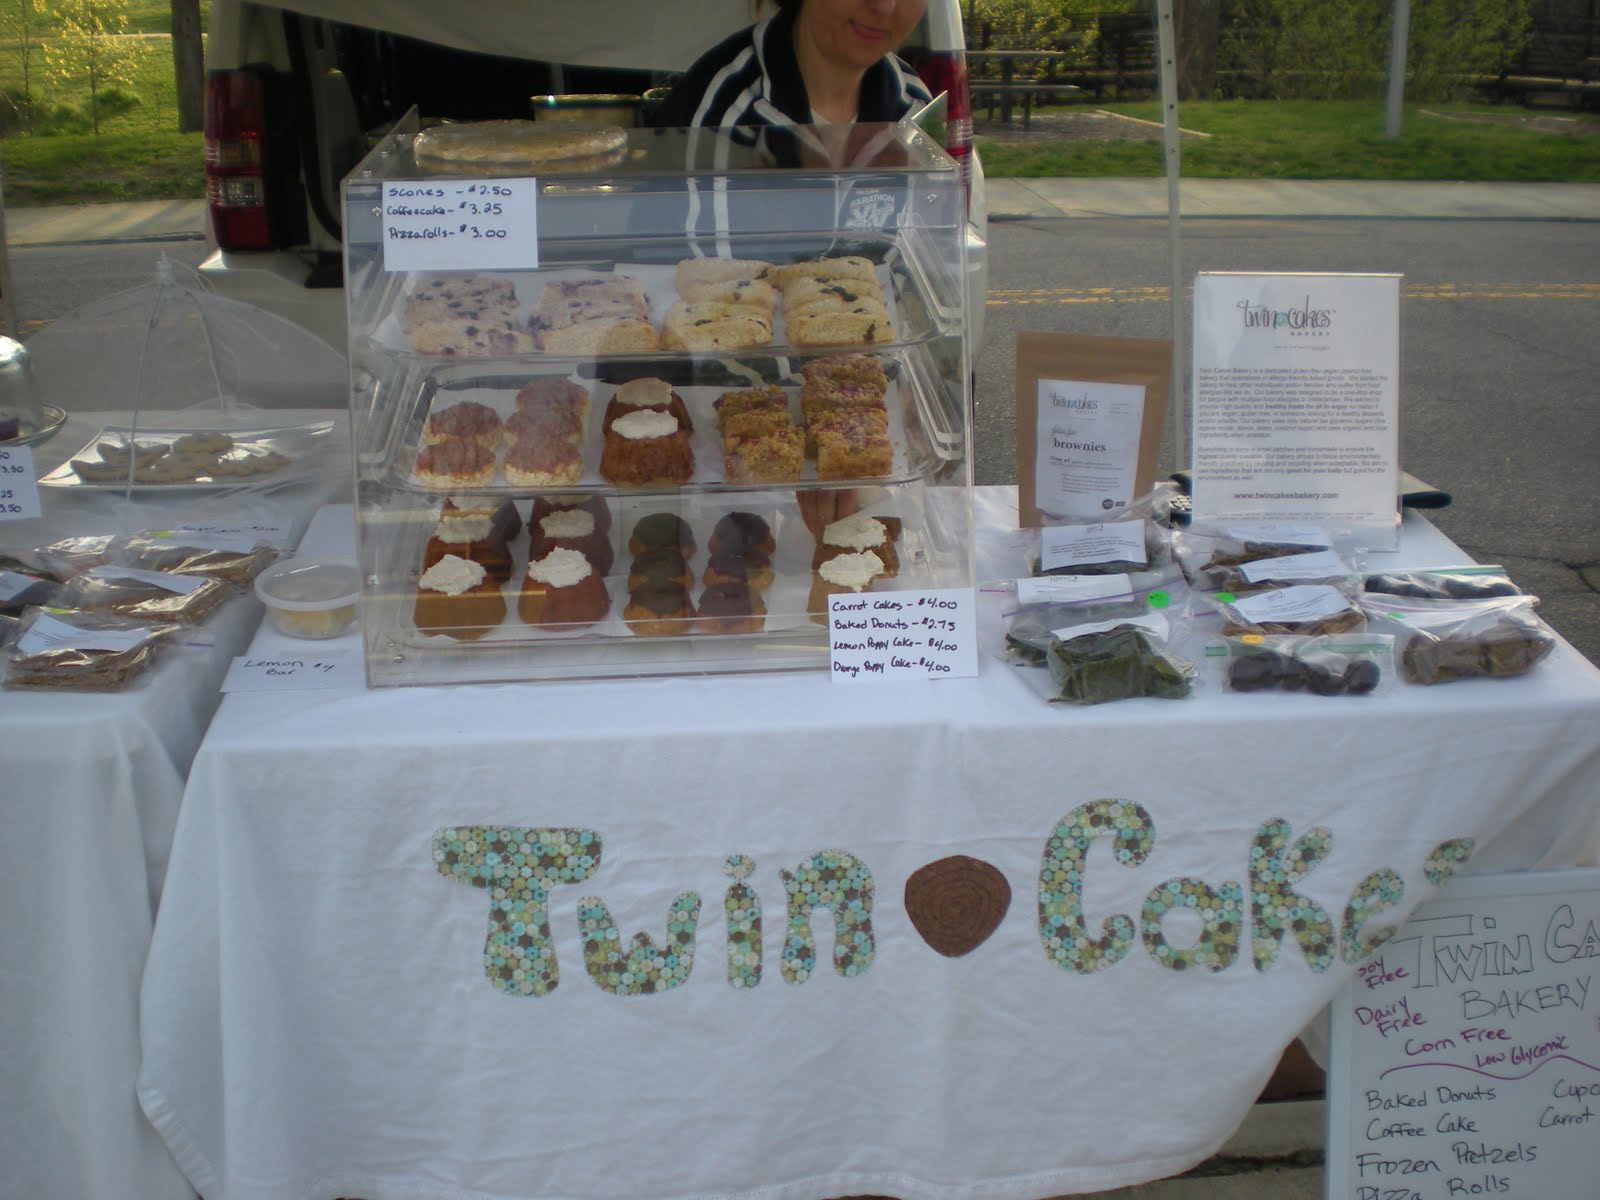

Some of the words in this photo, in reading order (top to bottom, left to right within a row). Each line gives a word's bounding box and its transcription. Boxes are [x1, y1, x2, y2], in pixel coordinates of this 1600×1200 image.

[1053, 437, 1107, 452] brownies
[1234, 490, 1339, 501] www.twincakesbakery.com
[832, 600, 868, 612] Carrot
[873, 600, 903, 611] Cakes
[834, 620, 868, 630] Baked
[871, 618, 909, 630] Donuts
[834, 641, 866, 650] Lemon
[244, 660, 304, 668] Lemon
[266, 668, 297, 676] Bar
[431, 825, 876, 997] Twin
[1365, 967, 1410, 990] Free
[1460, 975, 1592, 1020] BAKERY
[1354, 995, 1411, 1025] Dairy
[1377, 1012, 1428, 1038] Free
[1405, 1038, 1456, 1056] Corn
[1460, 1028, 1512, 1043] Free
[1365, 1089, 1428, 1111] Baked
[1436, 1085, 1497, 1104] Donuts
[1366, 1117, 1427, 1141] Coffee
[1436, 1112, 1480, 1133] Cake
[1539, 1105, 1595, 1128] Carrot
[1356, 1152, 1441, 1178] Frozen
[1452, 1141, 1538, 1165] Pretzels
[1446, 1174, 1511, 1195] Rolls
